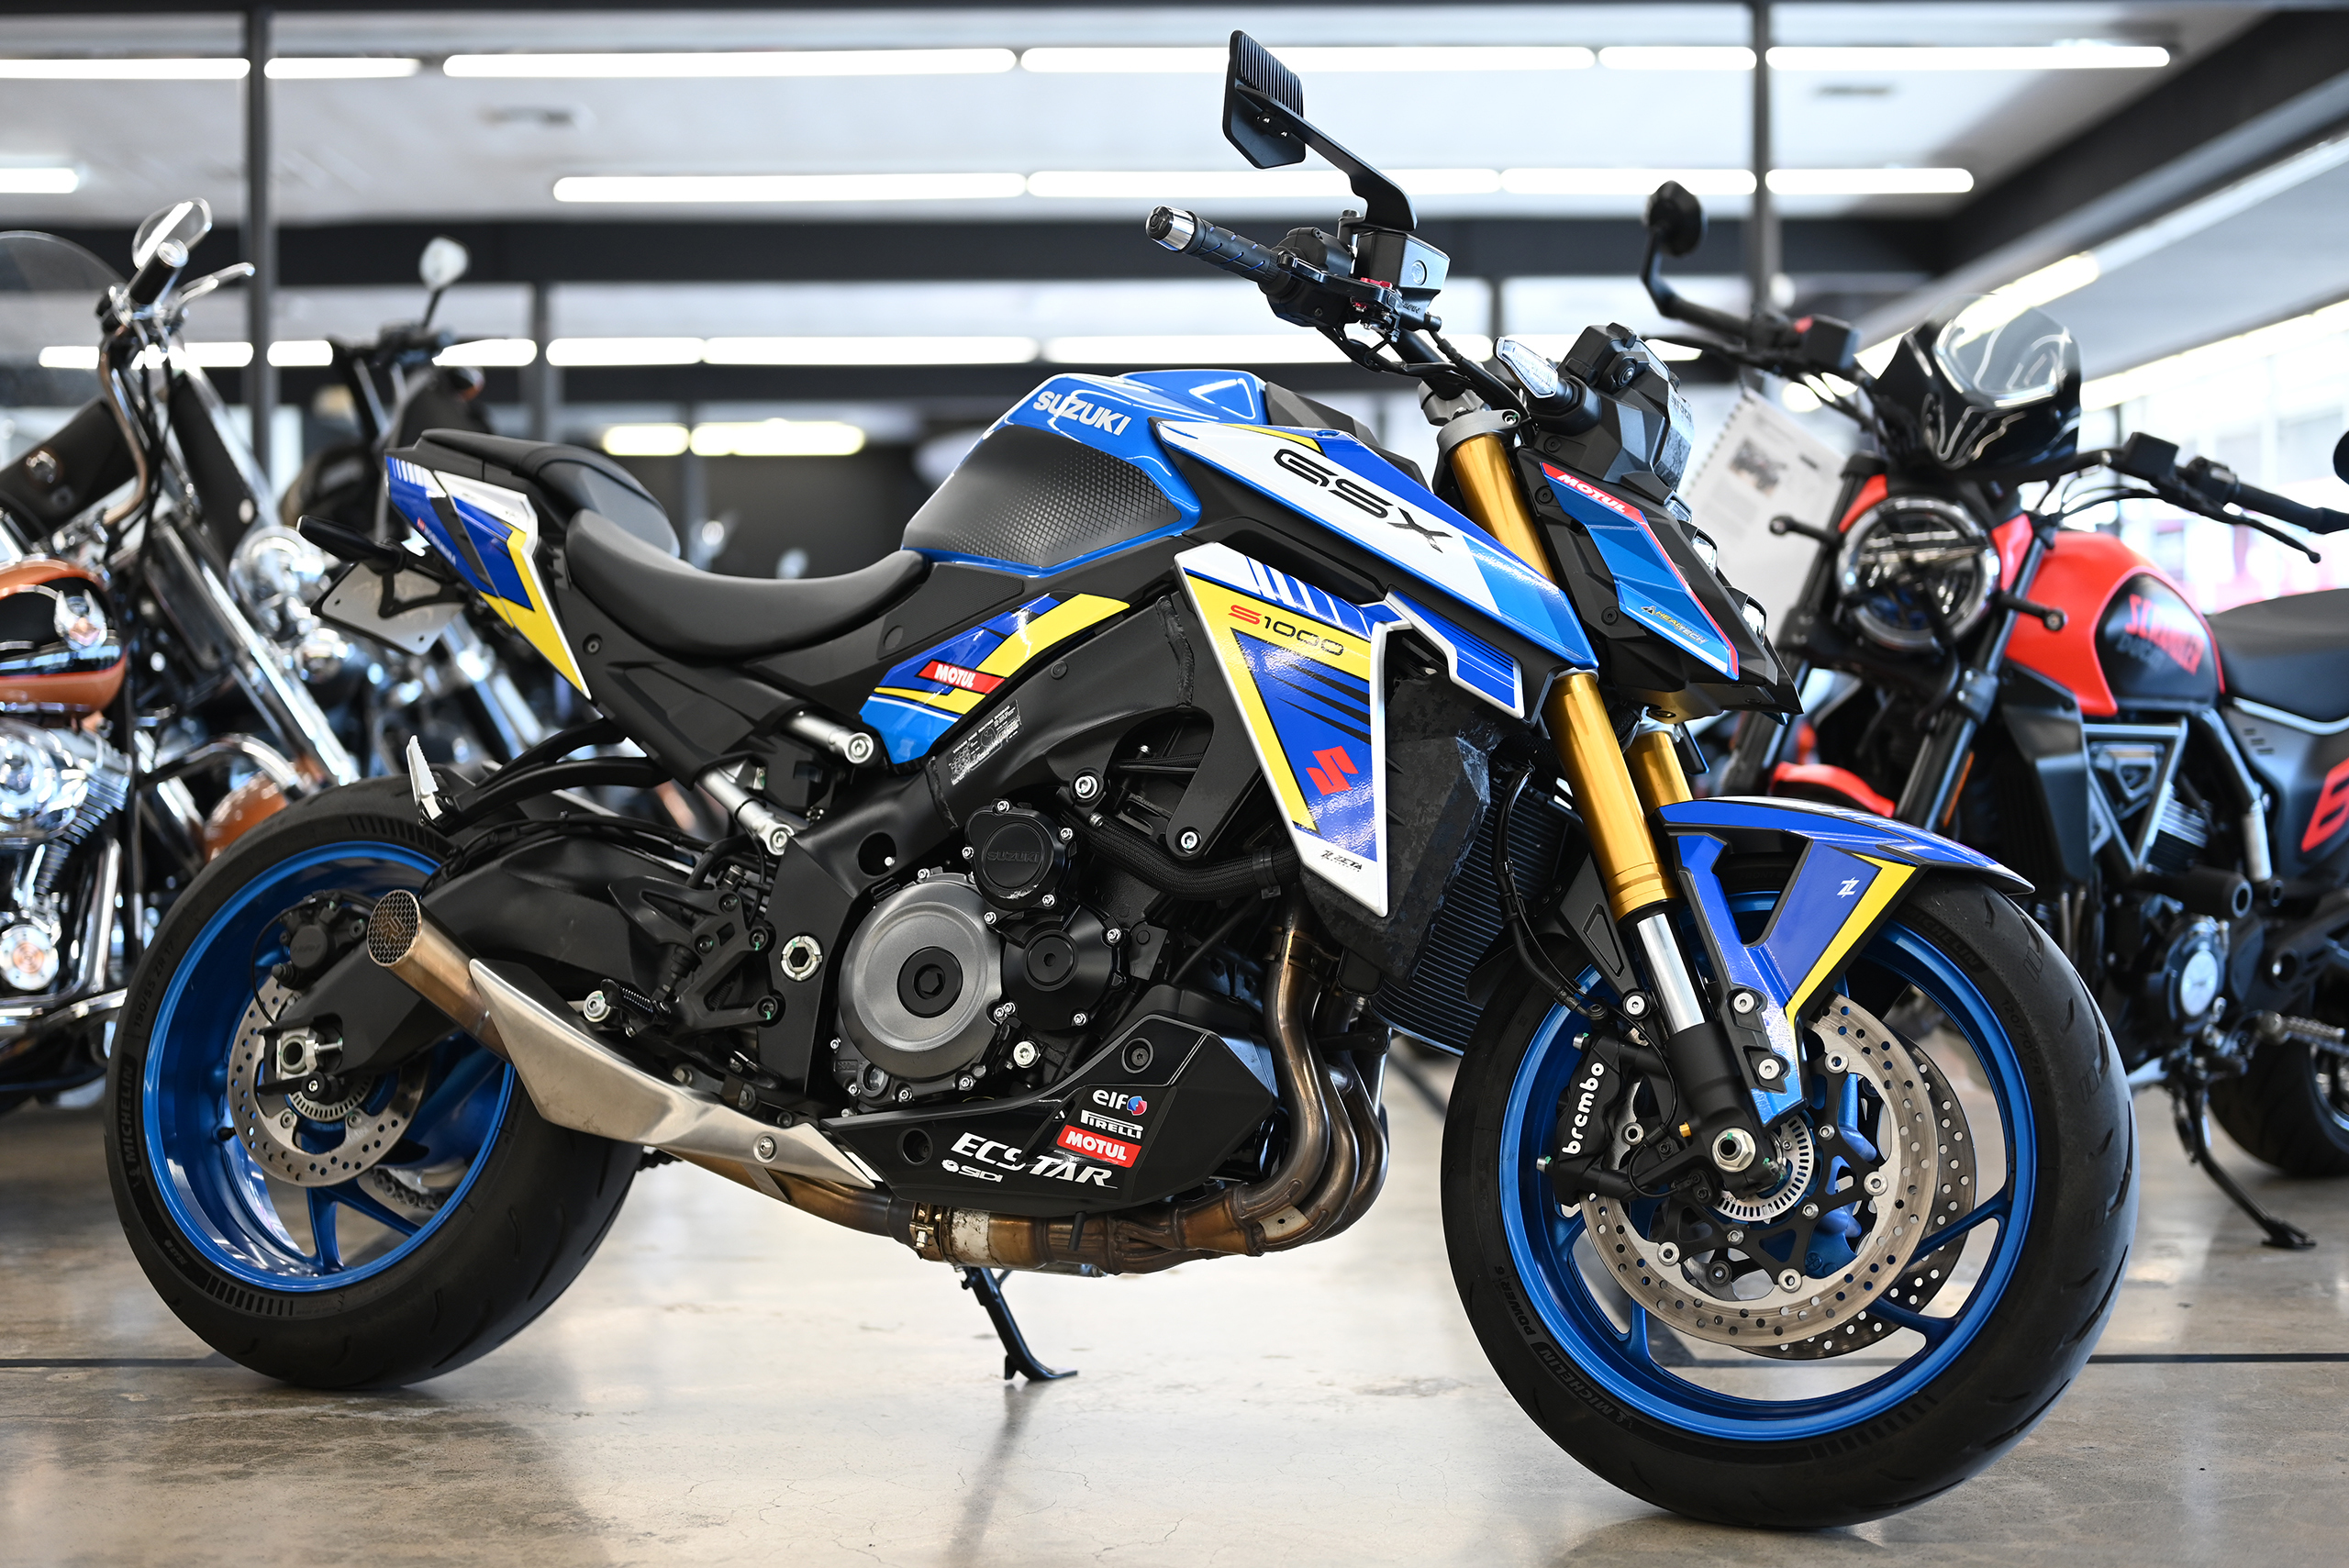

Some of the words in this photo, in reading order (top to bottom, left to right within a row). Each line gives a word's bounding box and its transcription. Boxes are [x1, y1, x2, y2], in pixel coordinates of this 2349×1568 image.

[1033, 391, 1132, 436] SUZUKI
[1274, 449, 1453, 553] GSX
[1557, 474, 1625, 513] MOTUL
[1228, 605, 1343, 656] S1000
[934, 663, 976, 688] MOTUL
[986, 850, 1041, 862] SUZUKI
[1901, 904, 1980, 966] MICHELIN
[133, 981, 155, 1028] 190/55
[153, 958, 167, 979] ZR
[164, 940, 174, 957] 17
[2001, 999, 2033, 1049] 120/70
[2028, 1054, 2043, 1076] ZR
[2037, 1083, 2048, 1097] 17
[119, 1065, 135, 1163] MICHELIN
[1080, 1109, 1143, 1140] PIRELLI
[1093, 1089, 1129, 1110] elf
[951, 1132, 1118, 1189] ECSTAR
[1065, 1130, 1127, 1161] MOTUL
[1500, 1281, 1537, 1336] POWER
[1539, 1349, 1615, 1416] MICHELIN
